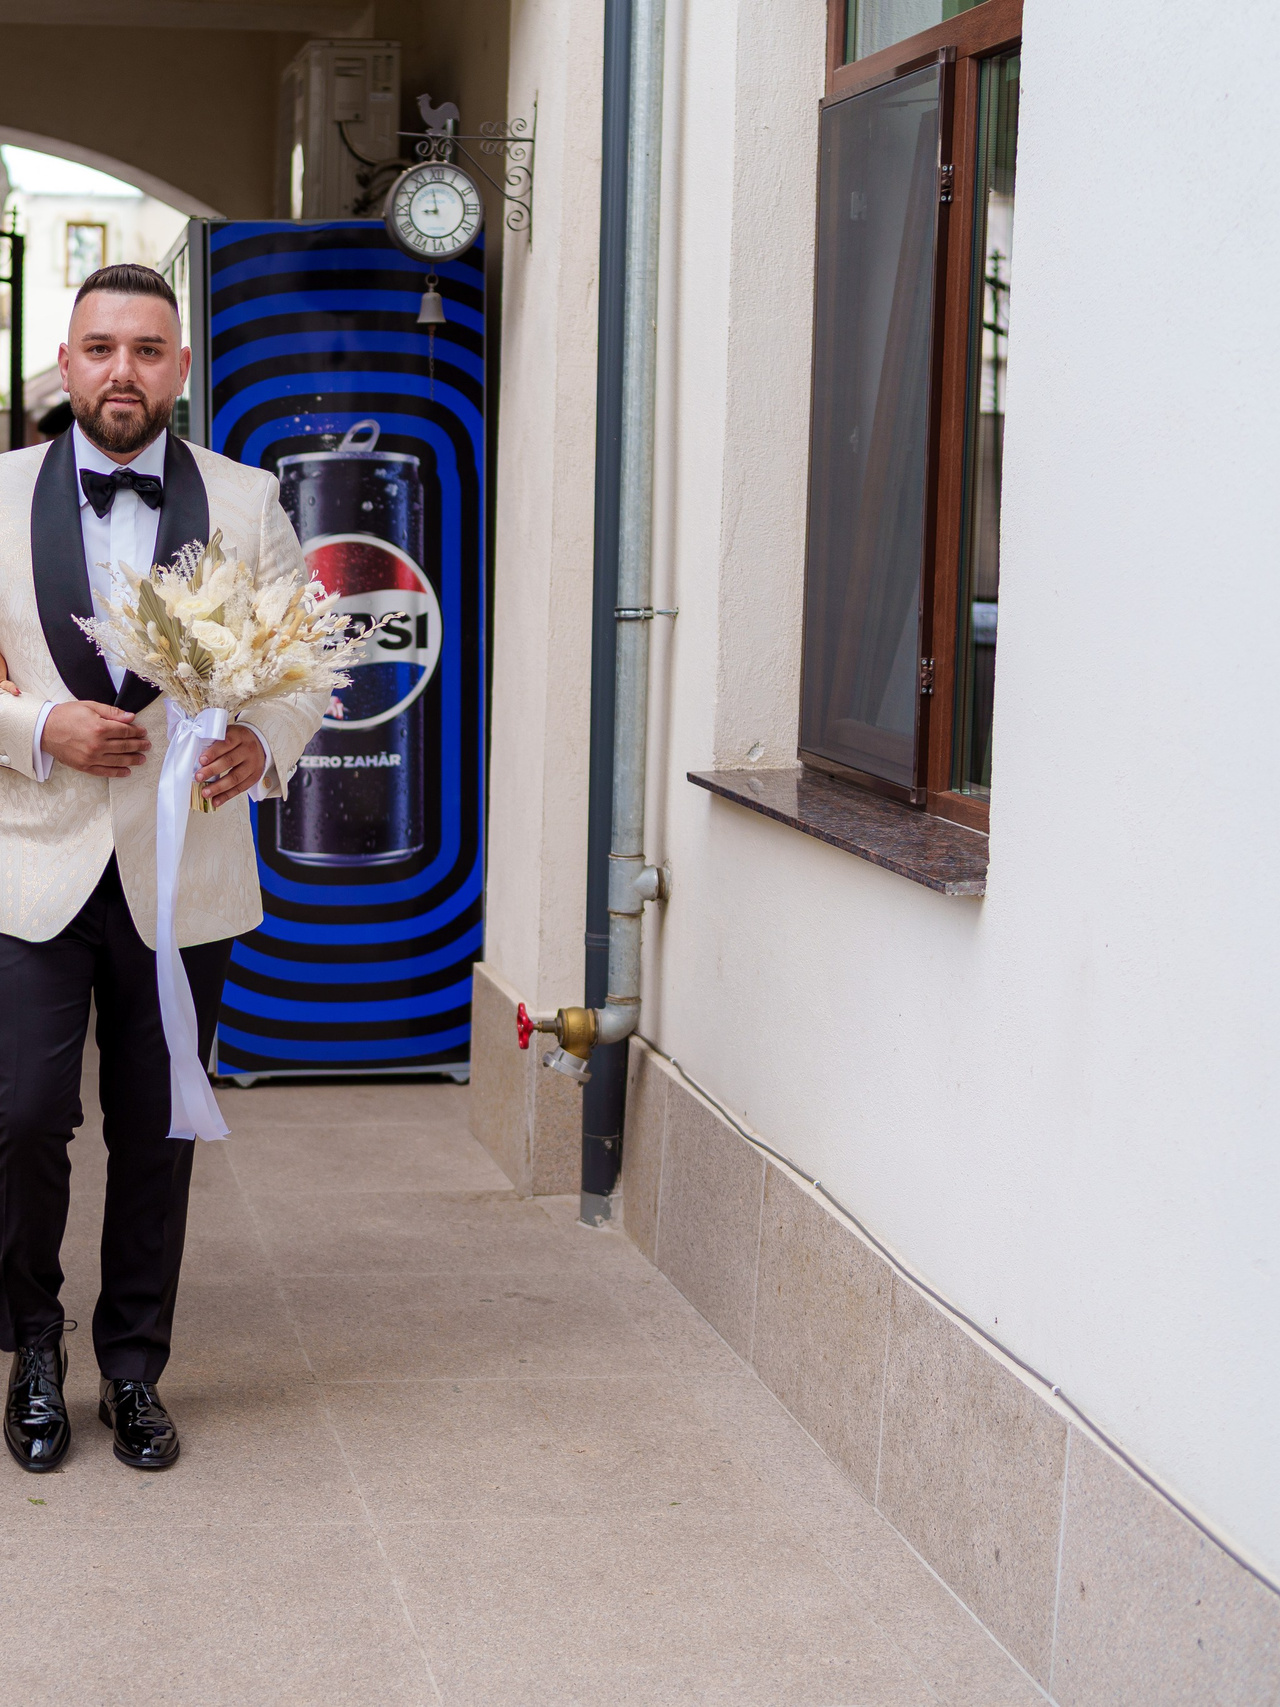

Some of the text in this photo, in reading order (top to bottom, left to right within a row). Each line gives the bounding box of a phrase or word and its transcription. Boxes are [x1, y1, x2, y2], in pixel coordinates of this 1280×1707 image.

[429, 168, 445, 180] XII
[450, 172, 459, 184] I
[401, 185, 415, 200] X
[461, 186, 474, 197] II
[396, 203, 410, 216] IX
[465, 203, 480, 216] III
[400, 220, 415, 238] VIII
[460, 219, 477, 236] IV
[413, 234, 428, 251] VII
[432, 239, 446, 252] VI
[451, 234, 462, 248] V
[320, 611, 429, 650] PSI
[299, 752, 401, 768] ZERO ZAHĂR
